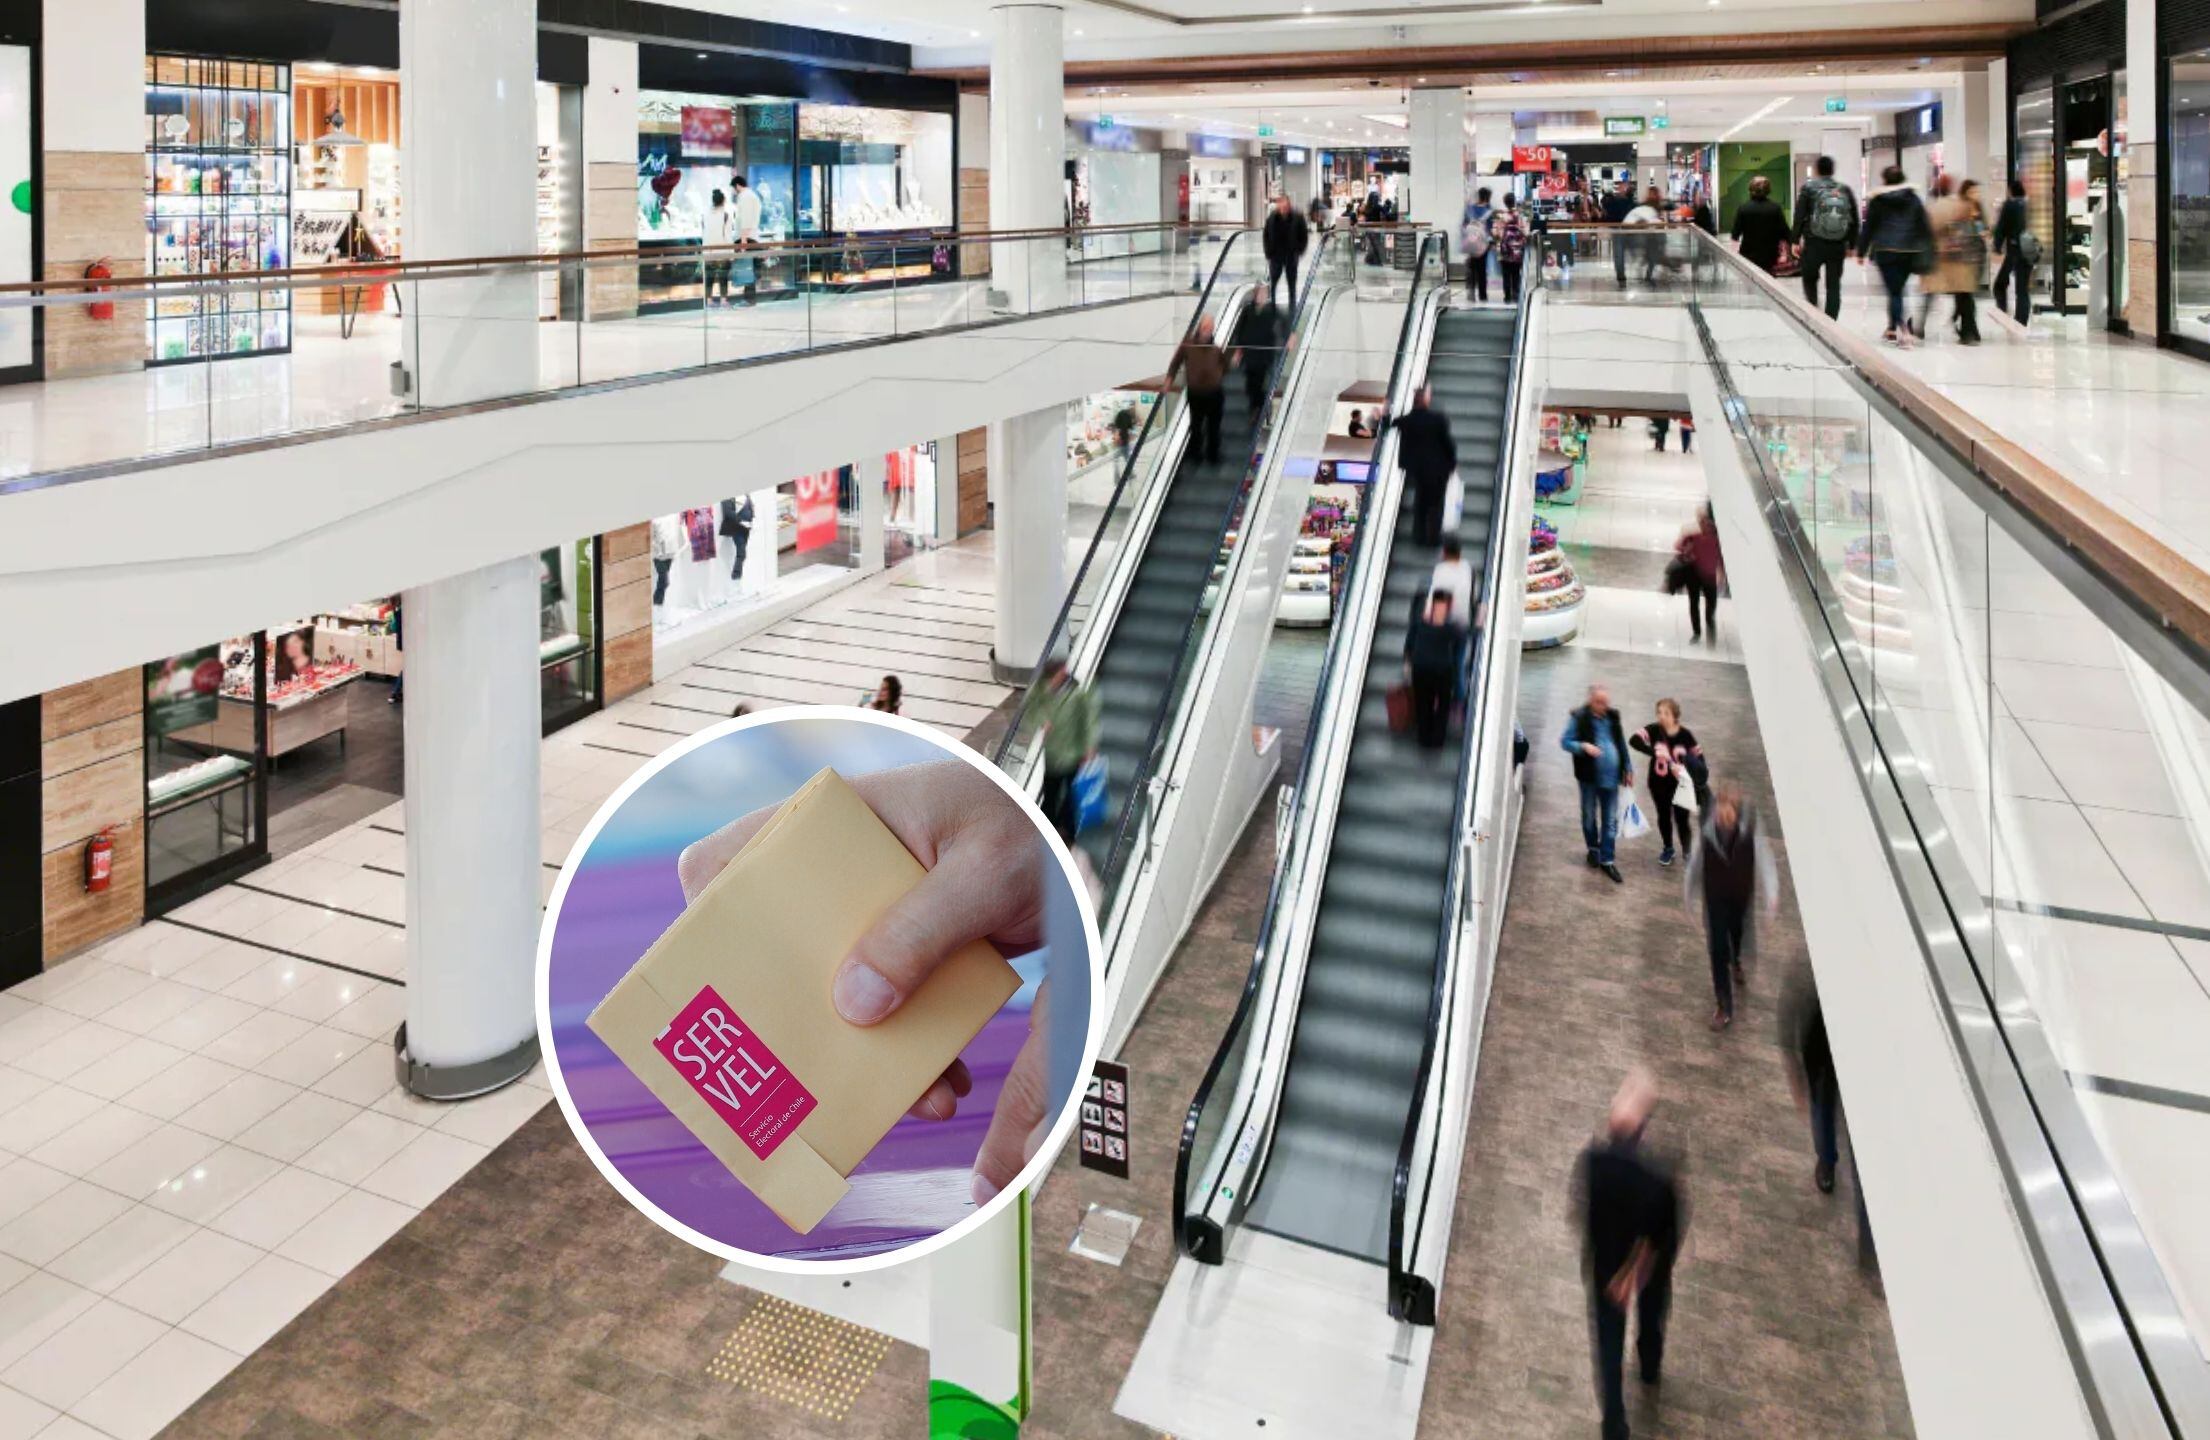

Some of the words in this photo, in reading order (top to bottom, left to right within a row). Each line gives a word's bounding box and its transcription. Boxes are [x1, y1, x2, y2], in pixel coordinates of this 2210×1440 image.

[673, 1007, 743, 1081] SER
[702, 1046, 777, 1111] VEL
[748, 1114, 774, 1140] Servicio
[755, 1119, 783, 1148] Electoral
[781, 1111, 792, 1122] de
[788, 1096, 806, 1113] Chile
